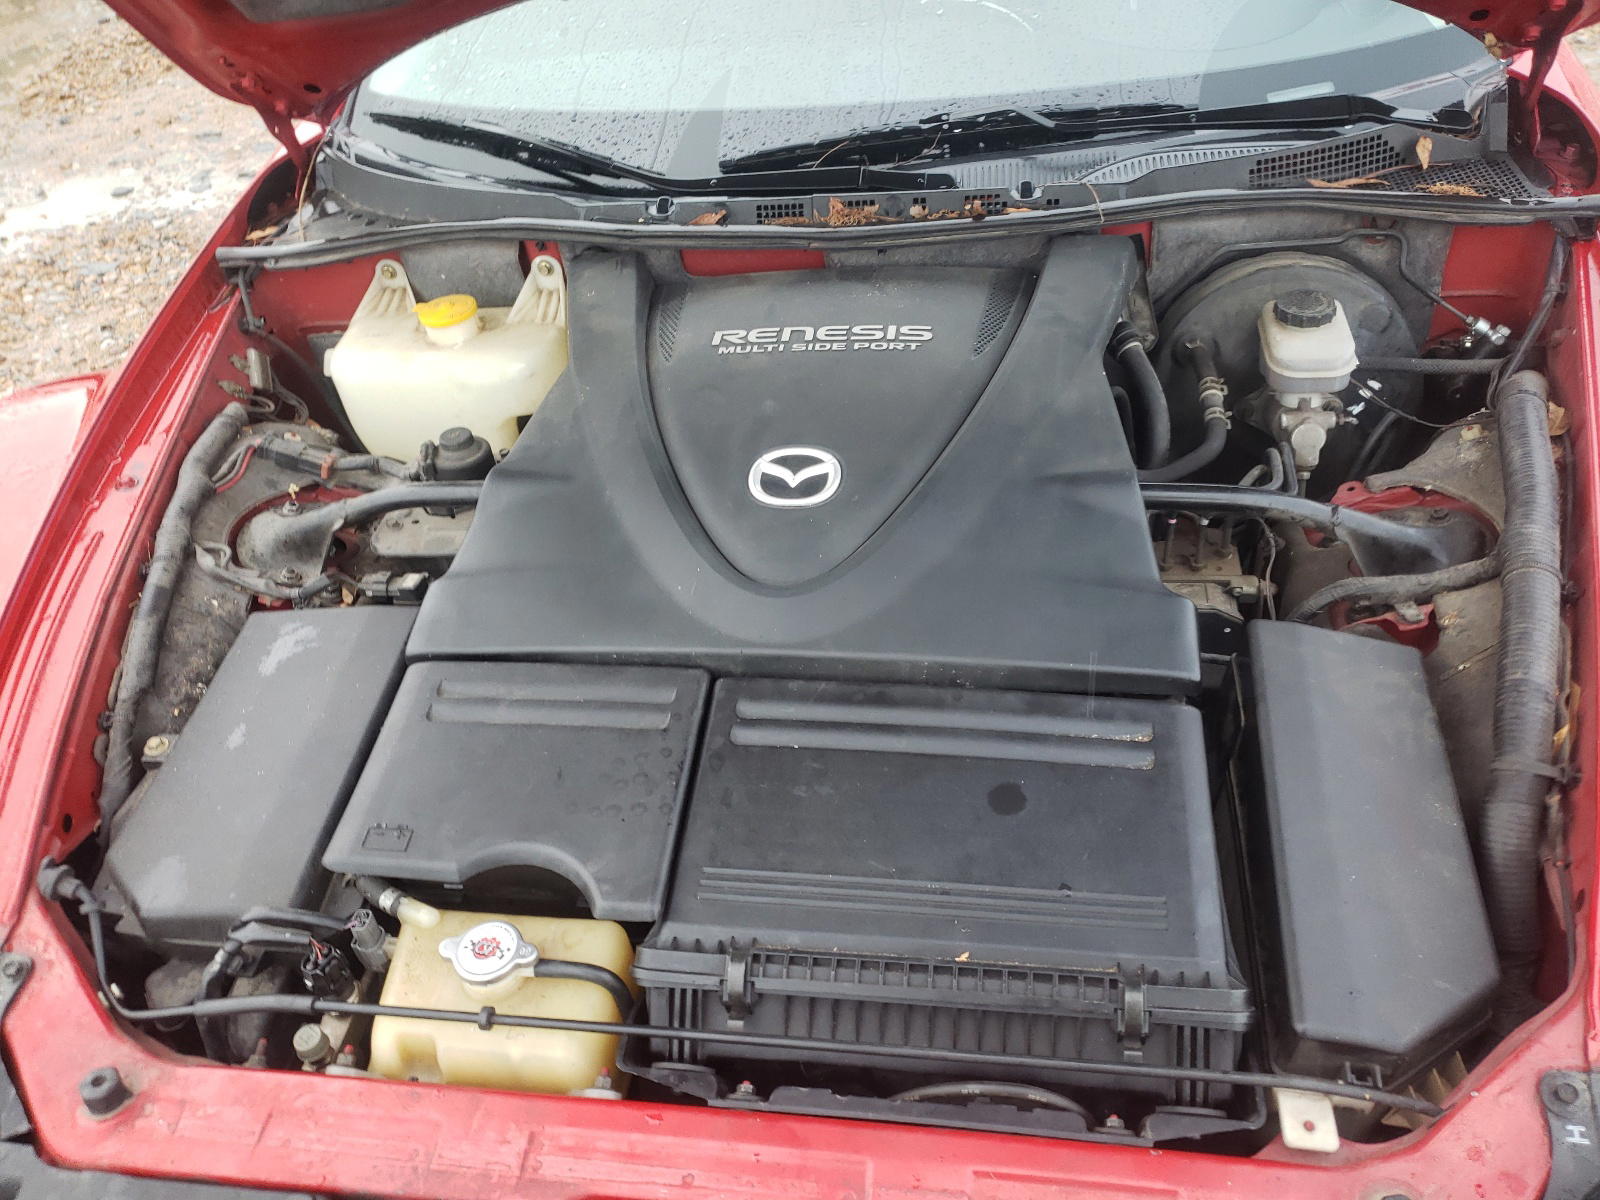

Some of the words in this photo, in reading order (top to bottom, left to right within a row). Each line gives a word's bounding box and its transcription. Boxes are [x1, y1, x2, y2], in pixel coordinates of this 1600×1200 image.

[711, 324, 933, 346] RENESIS
[717, 343, 784, 355] MULTI
[791, 342, 847, 351] SIDE
[853, 341, 923, 351] PORT
